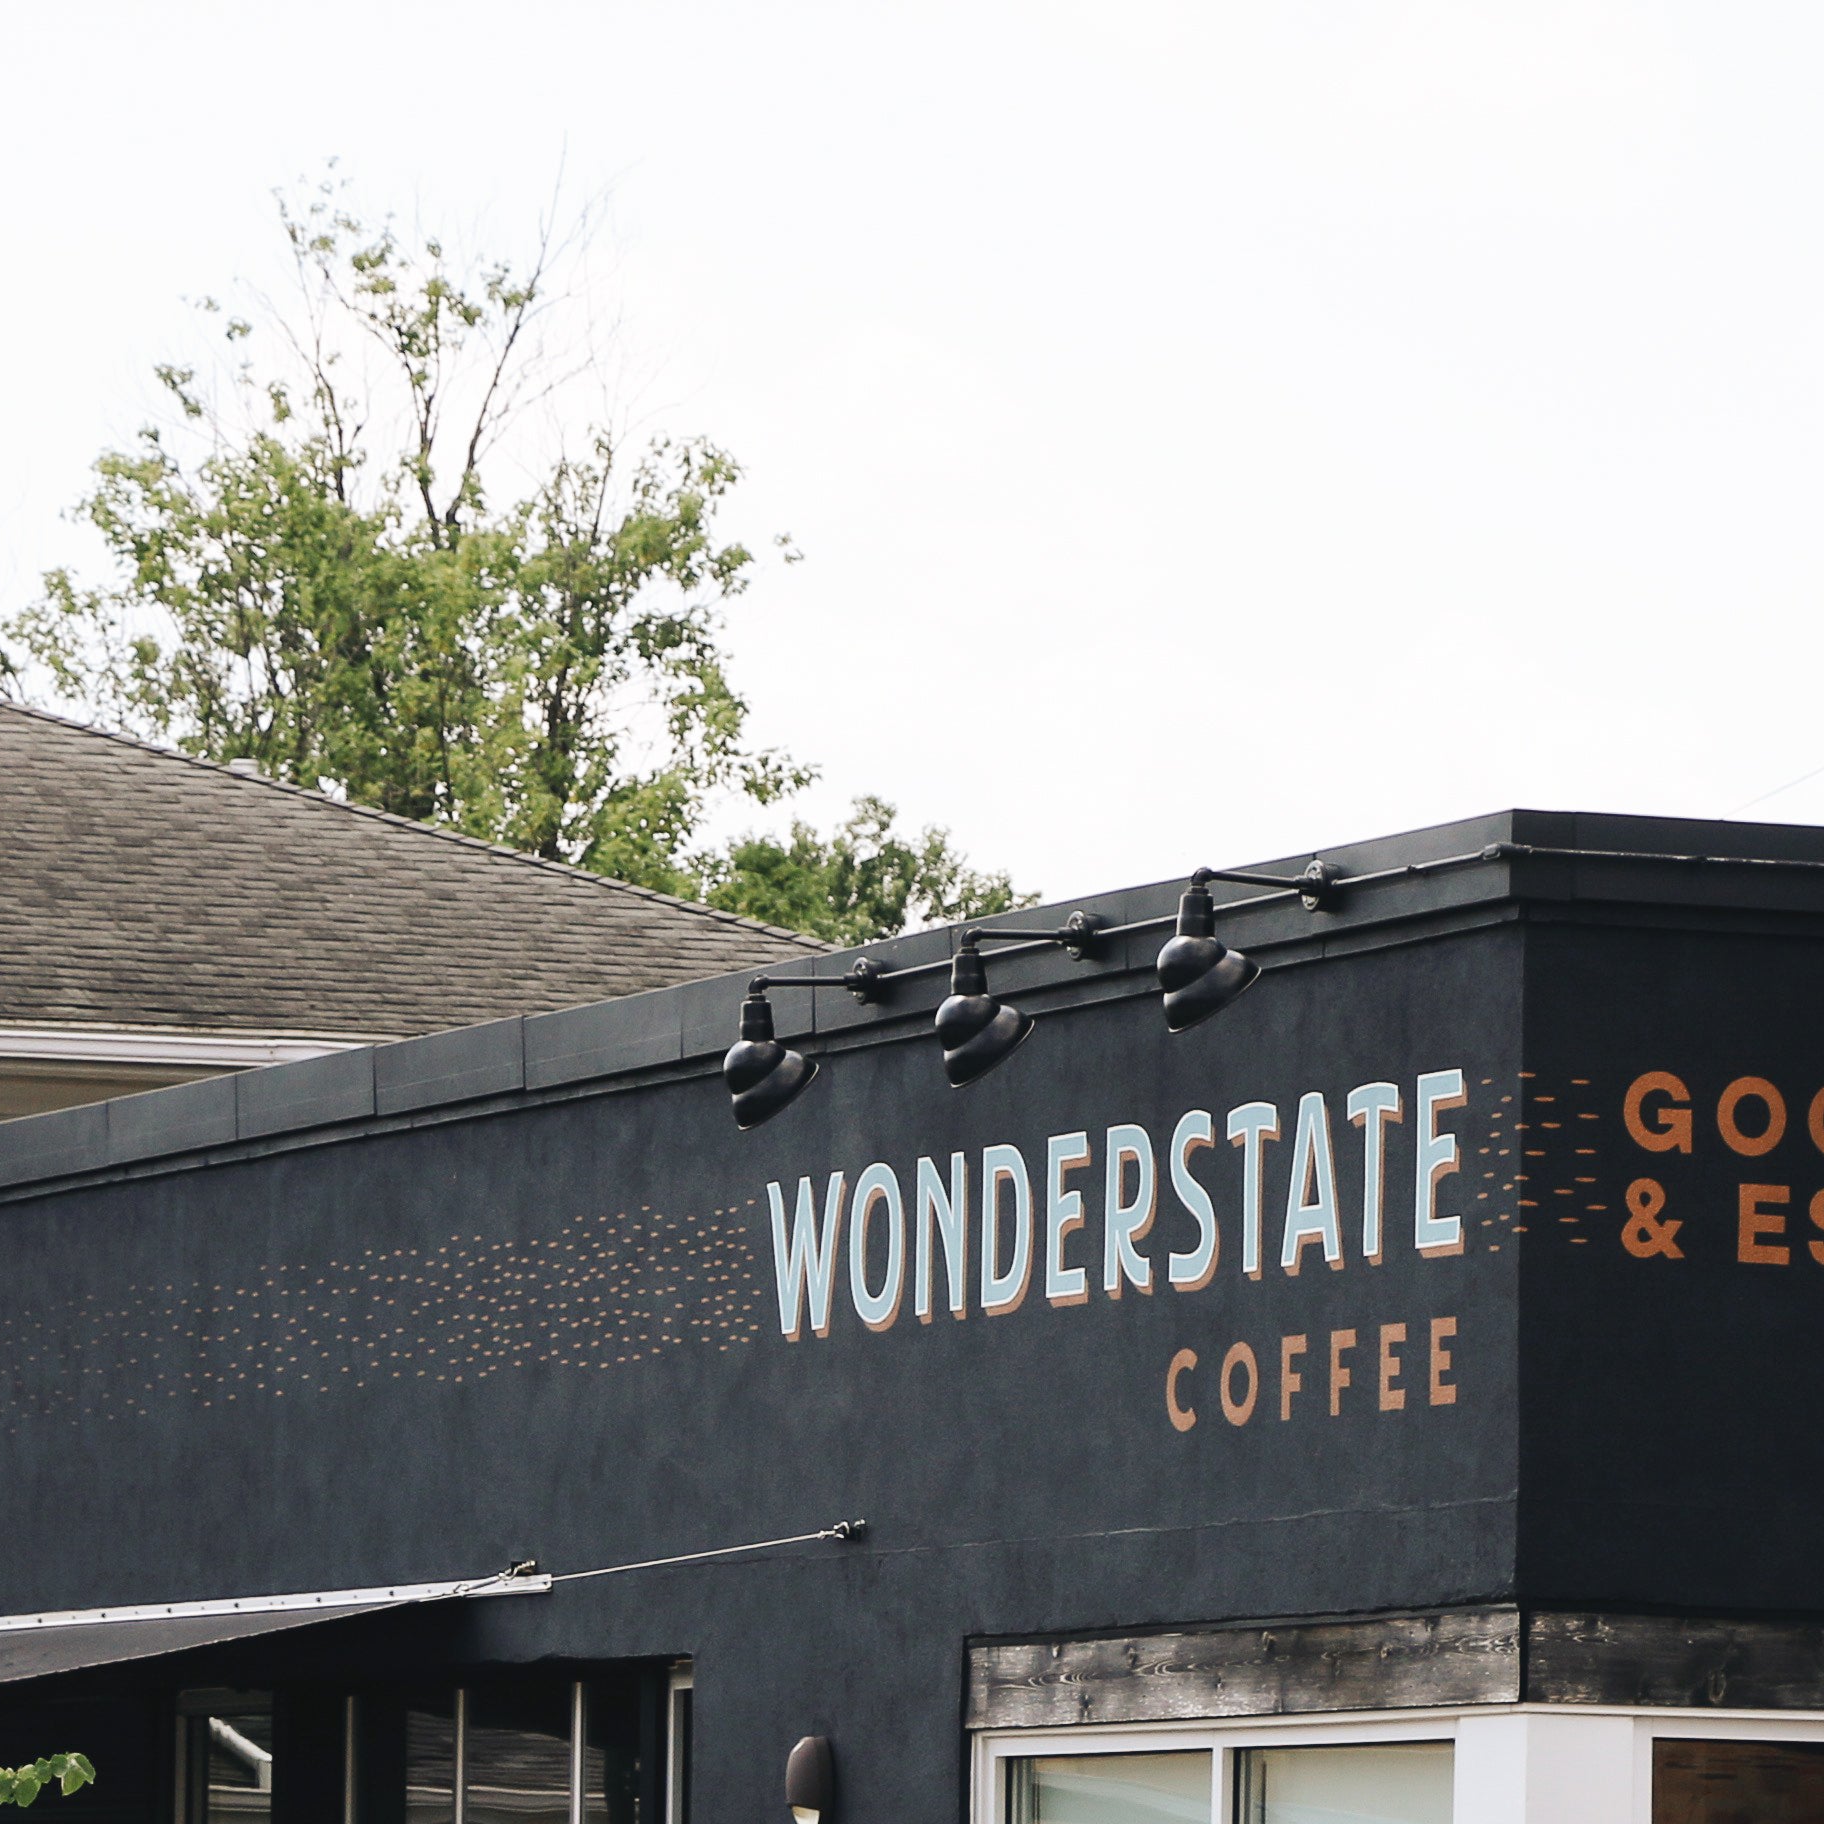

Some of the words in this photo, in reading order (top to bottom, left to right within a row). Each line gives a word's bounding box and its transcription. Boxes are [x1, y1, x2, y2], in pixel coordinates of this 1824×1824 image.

[767, 1069, 1468, 1343] WONDERSTATE
[1620, 1177, 1684, 1259] &
[1166, 1316, 1458, 1432] COFFEE
